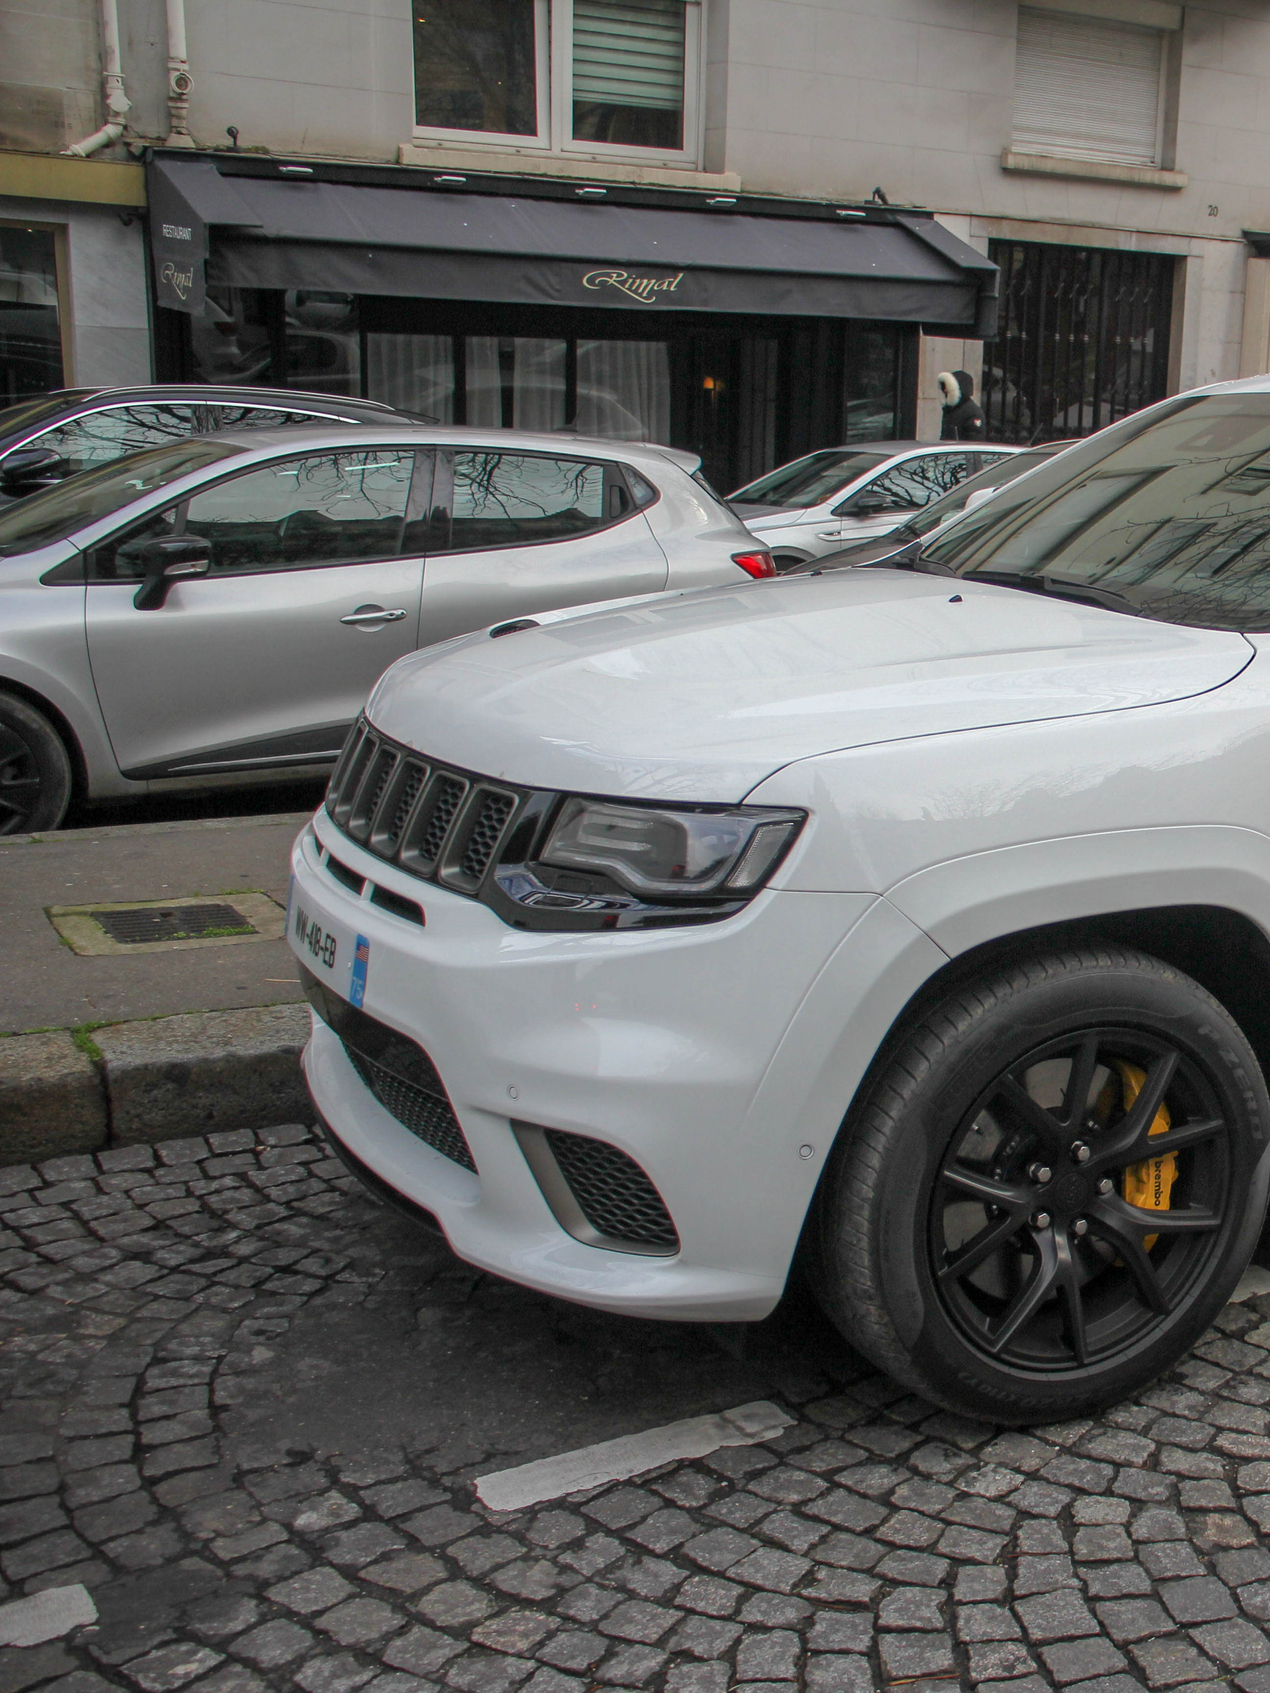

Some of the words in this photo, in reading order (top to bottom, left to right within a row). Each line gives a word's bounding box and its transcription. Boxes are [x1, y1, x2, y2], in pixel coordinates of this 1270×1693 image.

[1208, 204, 1219, 218] 20
[162, 224, 192, 240] RESTAURANT
[161, 262, 194, 300] Rimal
[582, 269, 684, 303] Rimal
[1154, 1160, 1163, 1207] brembo
